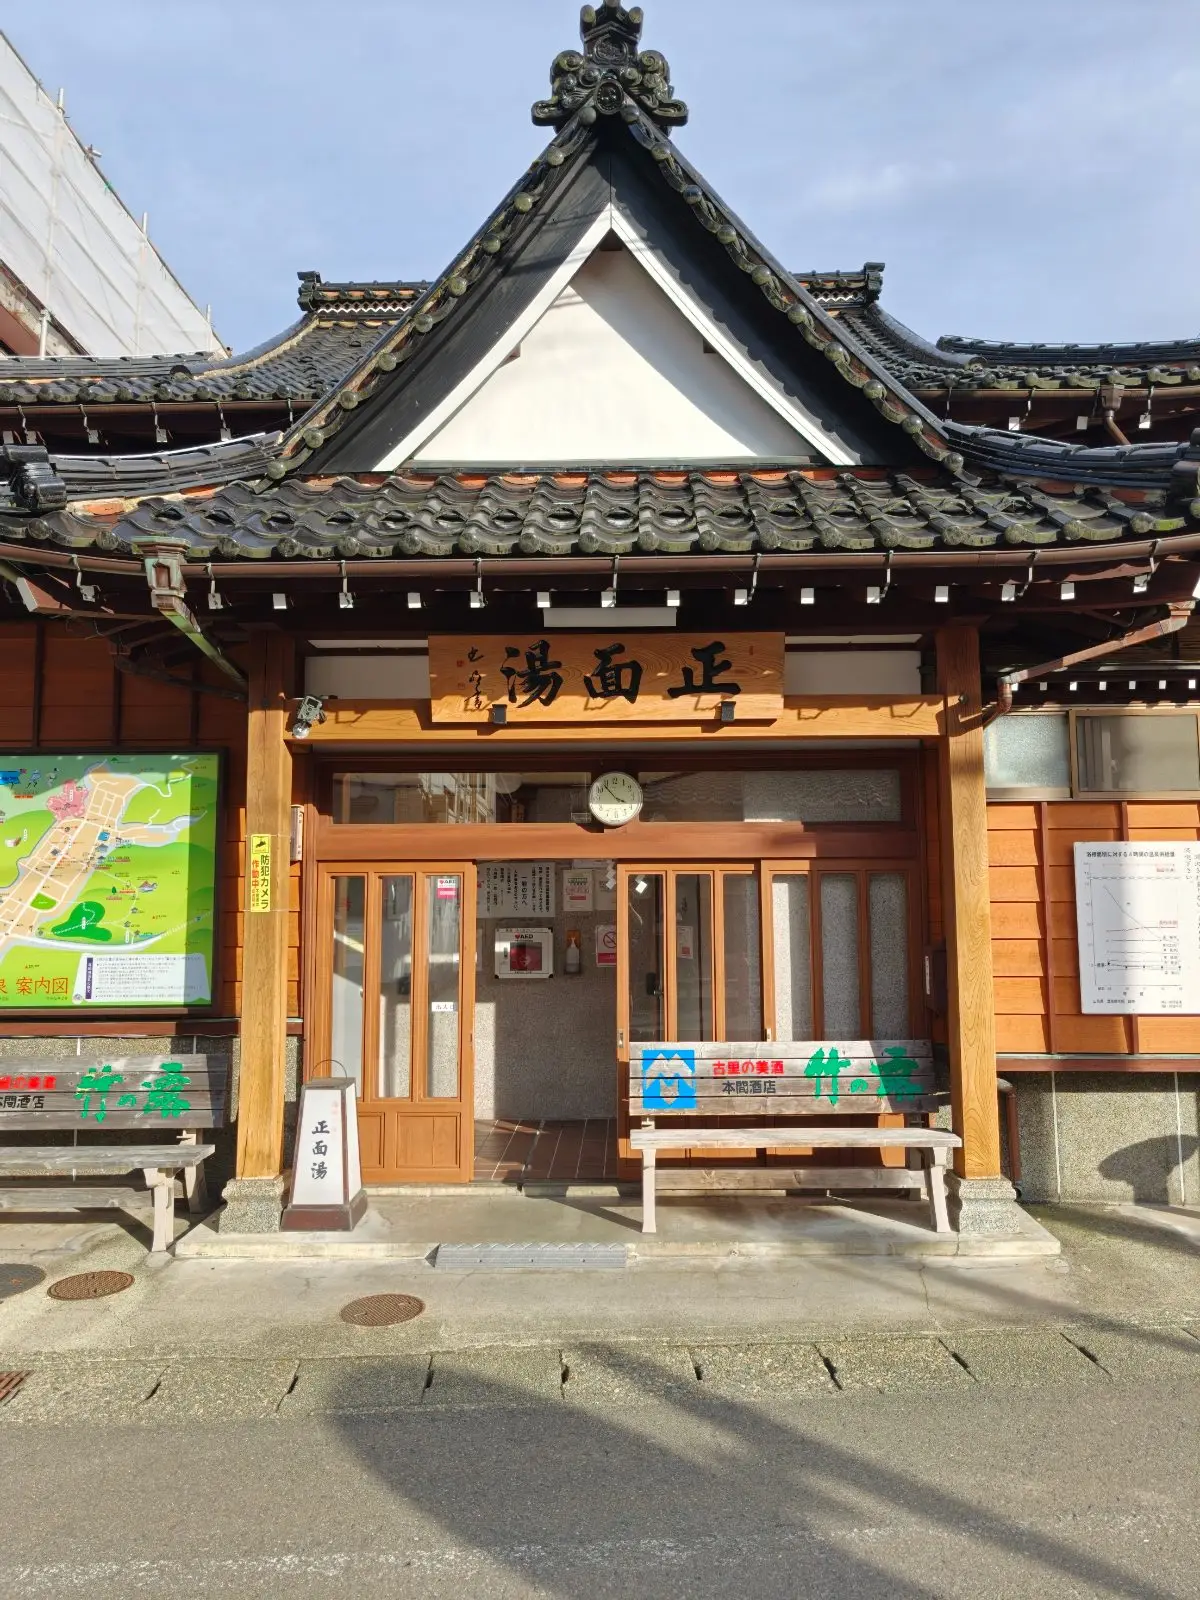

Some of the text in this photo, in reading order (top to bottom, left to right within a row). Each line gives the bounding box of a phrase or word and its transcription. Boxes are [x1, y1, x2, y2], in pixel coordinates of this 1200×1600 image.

[500, 639, 741, 708] 正面湯
[252, 859, 260, 888] 作動中
[260, 854, 270, 910] 防犯カメラ
[16, 976, 69, 996] 案内図
[712, 1060, 785, 1076] 古里の美酒
[722, 1080, 776, 1095] 本間酒店
[0, 1095, 45, 1109] 間酒店
[311, 1120, 330, 1180] 正面湯
